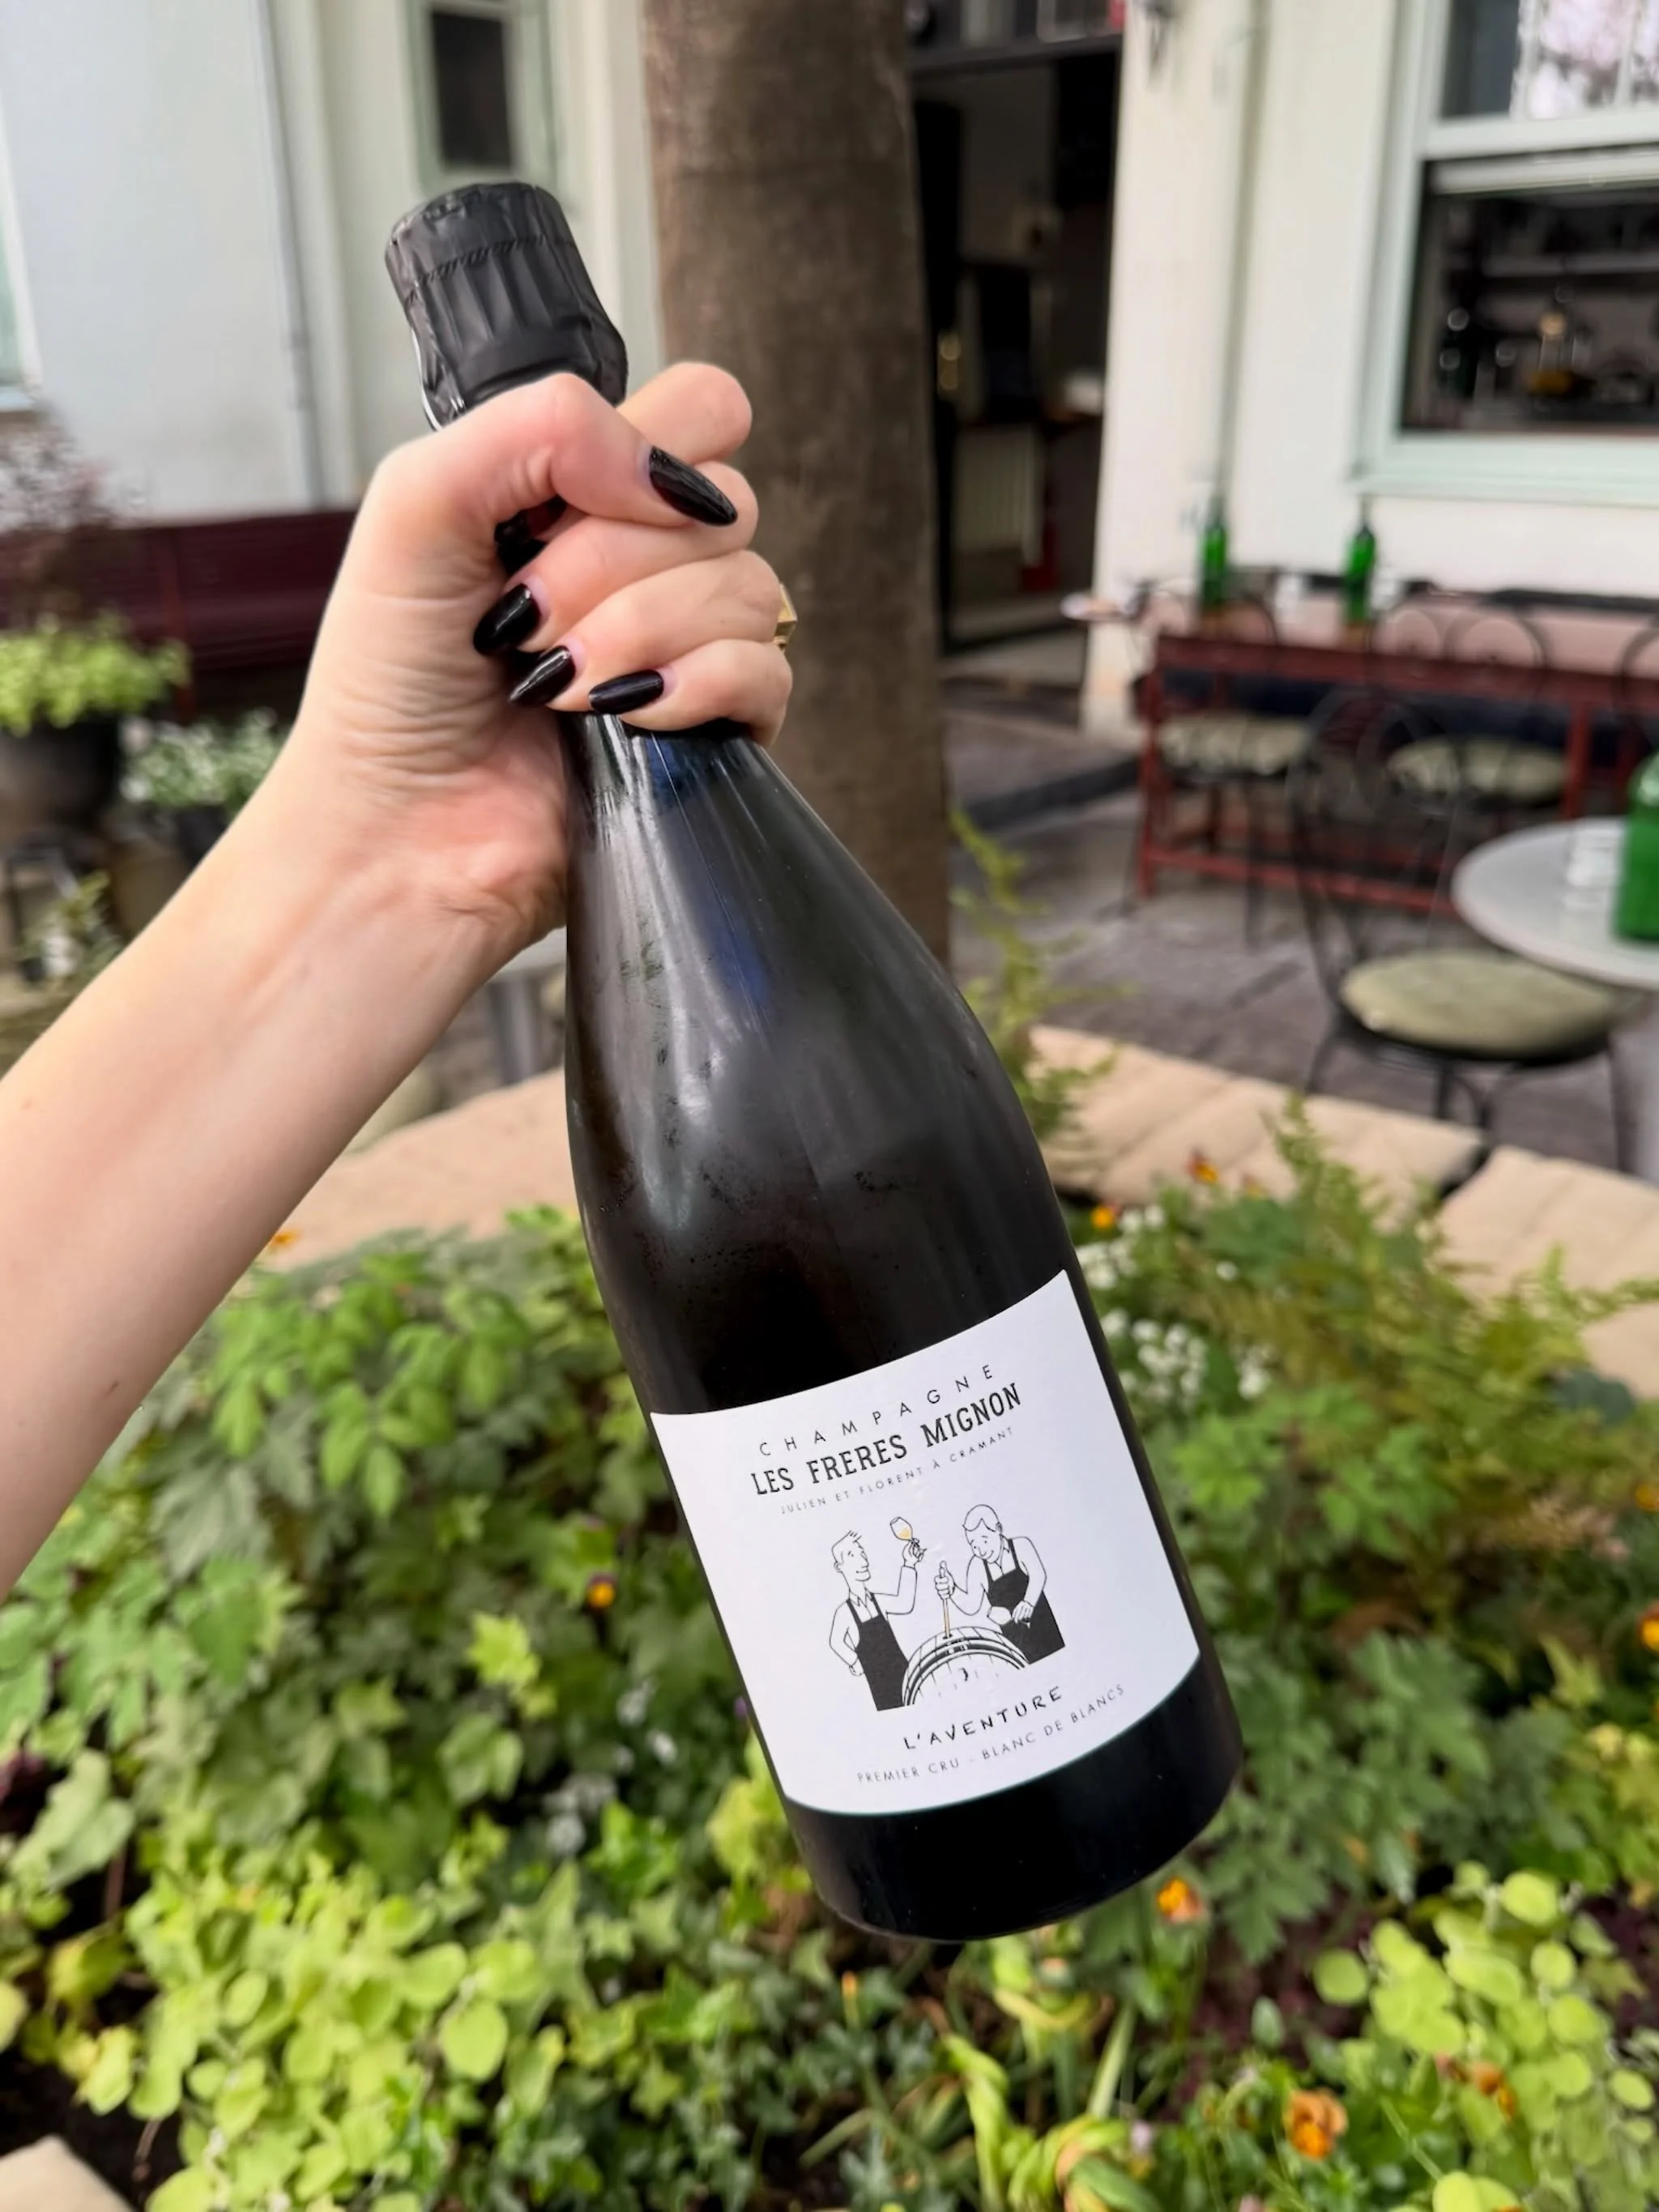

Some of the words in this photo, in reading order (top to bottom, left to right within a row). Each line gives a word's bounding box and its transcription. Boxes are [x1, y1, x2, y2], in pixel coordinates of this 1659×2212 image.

[751, 1468, 794, 1495] LES
[806, 1434, 907, 1484] FRERES
[919, 1383, 1021, 1448] MIGNON
[759, 1364, 993, 1456] CHAMPAGNE
[781, 1497, 826, 1515] JULIEN
[835, 1490, 850, 1502] ET
[859, 1467, 923, 1495] FLORENT
[949, 1426, 1013, 1463] CRAMANT
[857, 1767, 919, 1784] PREMIER
[928, 1758, 959, 1774] CRU
[982, 1733, 1036, 1760] BLANC
[1043, 1719, 1064, 1736] DE
[1070, 1684, 1124, 1724] BLANCS
[903, 1686, 1063, 1750] L'AVENTURE
